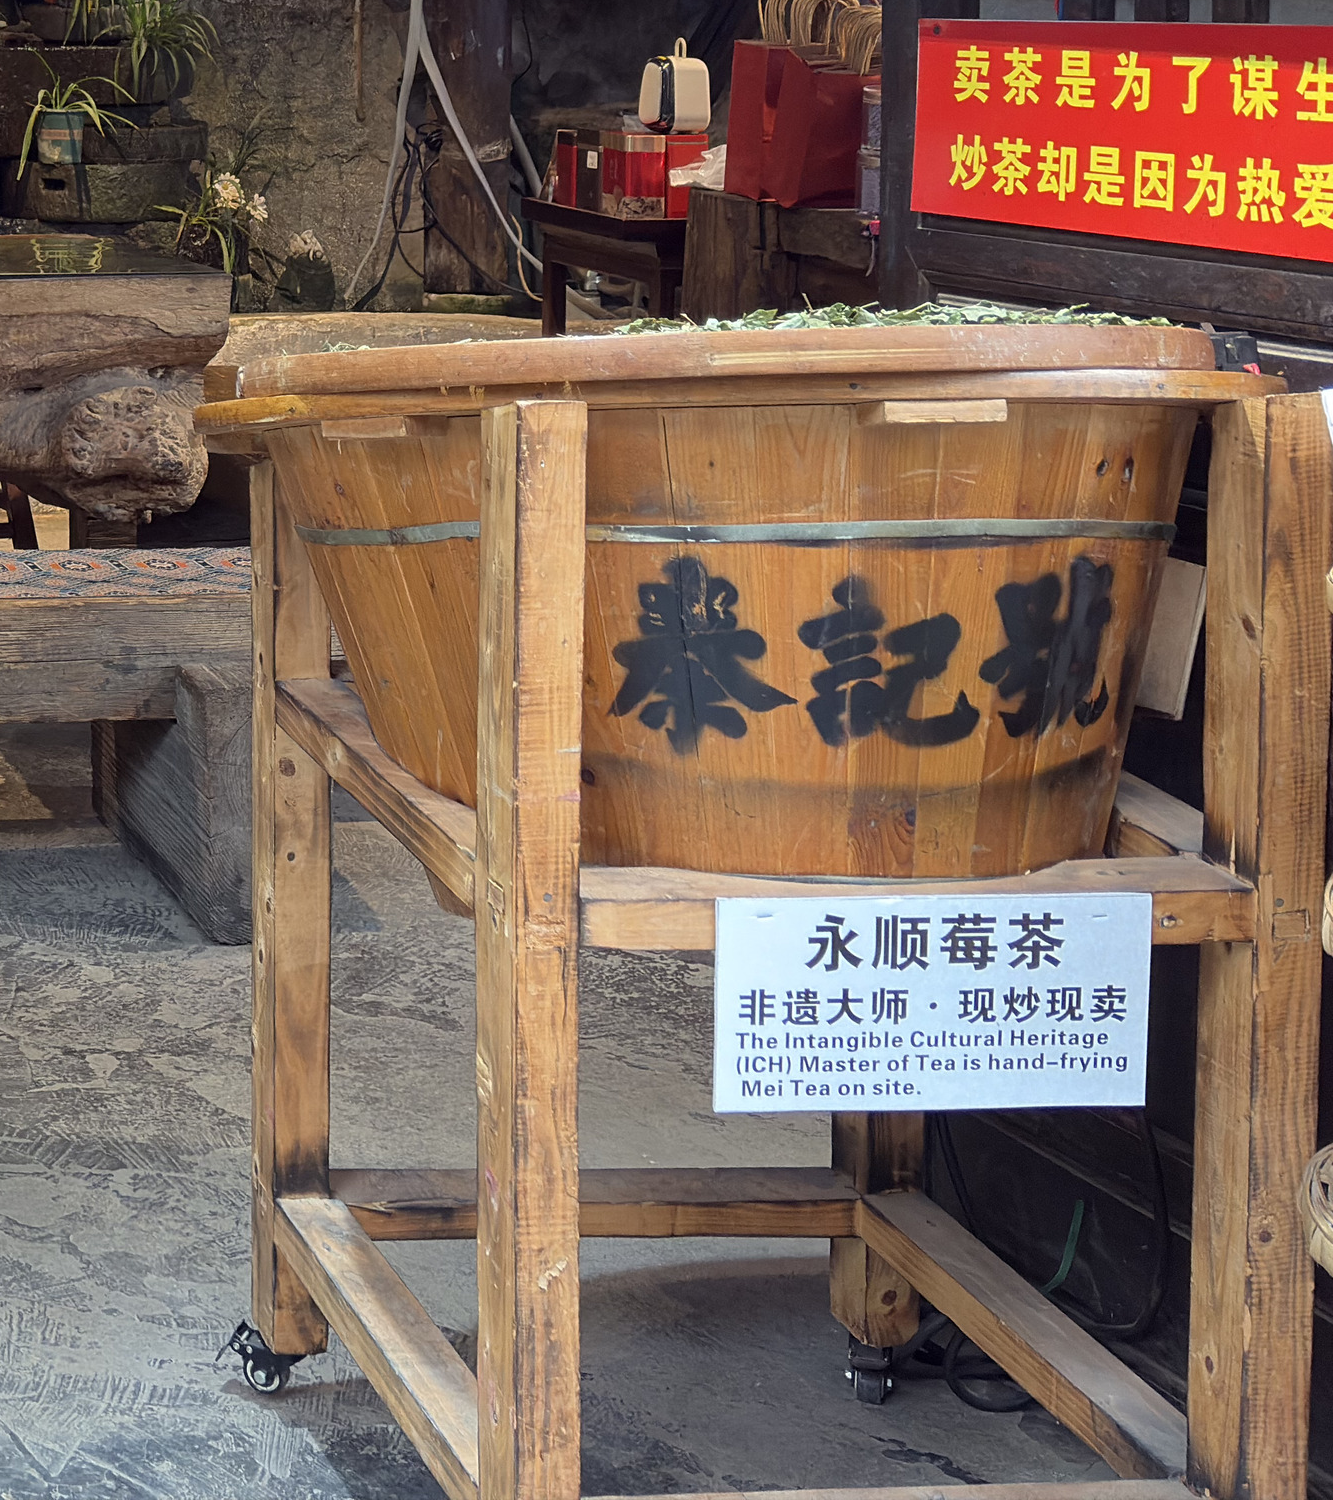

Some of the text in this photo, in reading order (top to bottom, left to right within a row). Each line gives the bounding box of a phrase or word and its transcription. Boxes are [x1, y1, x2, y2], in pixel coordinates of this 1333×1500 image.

[953, 45, 1333, 122] 卖茶是为了谋生
[949, 134, 1333, 228] 炒茶却是因为热爱
[805, 912, 1065, 972] 永顺莓茶
[736, 1029, 1109, 1053] The Intangible Cultural Heritage
[736, 1055, 792, 1075] (ICH)
[800, 1055, 880, 1073] Master
[887, 1053, 910, 1072] of
[915, 1054, 956, 1072] Tea
[963, 1053, 981, 1071] is
[741, 1078, 922, 1098] Mei Tea on site.
